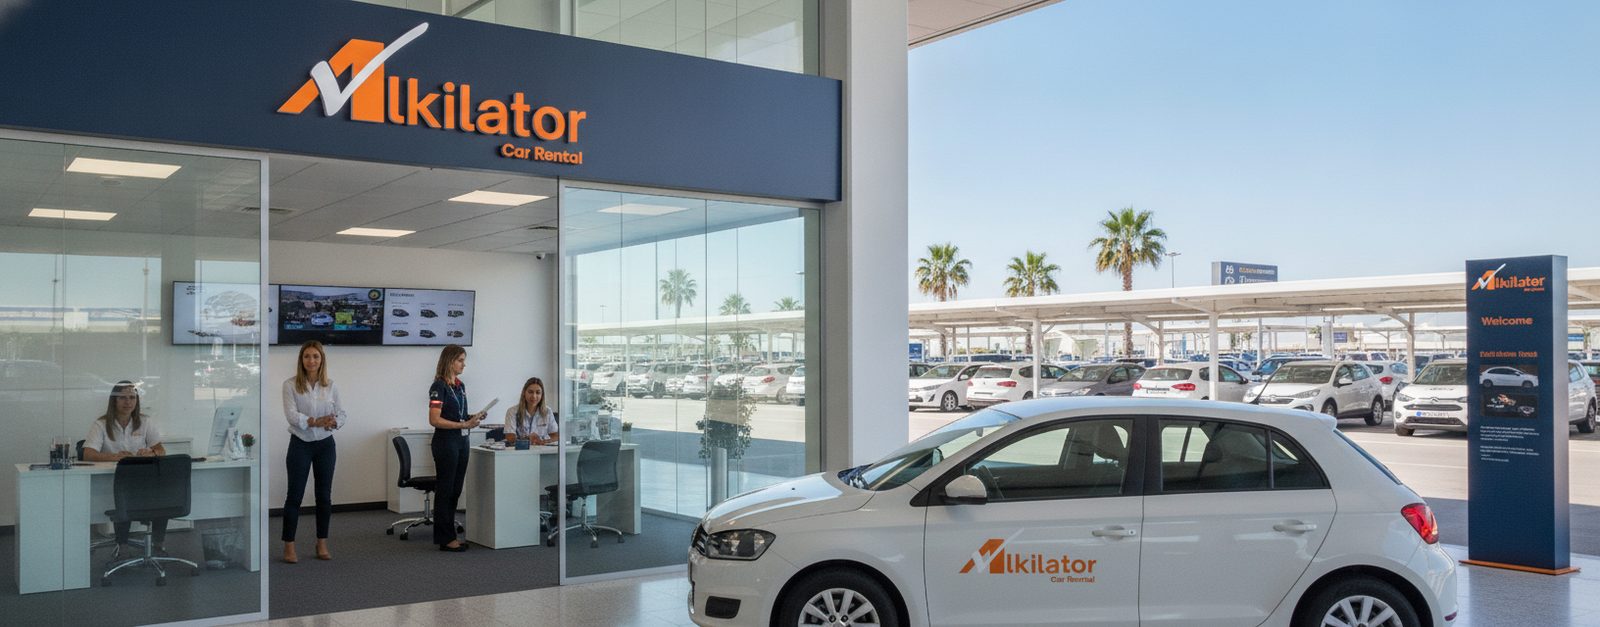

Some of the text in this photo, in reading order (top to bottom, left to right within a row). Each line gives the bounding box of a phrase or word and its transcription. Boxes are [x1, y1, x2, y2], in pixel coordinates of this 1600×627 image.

[277, 38, 587, 143] Alkilator
[502, 143, 583, 165] Car Rental
[1481, 316, 1533, 326] Welcome
[959, 539, 1097, 574] Alkilator
